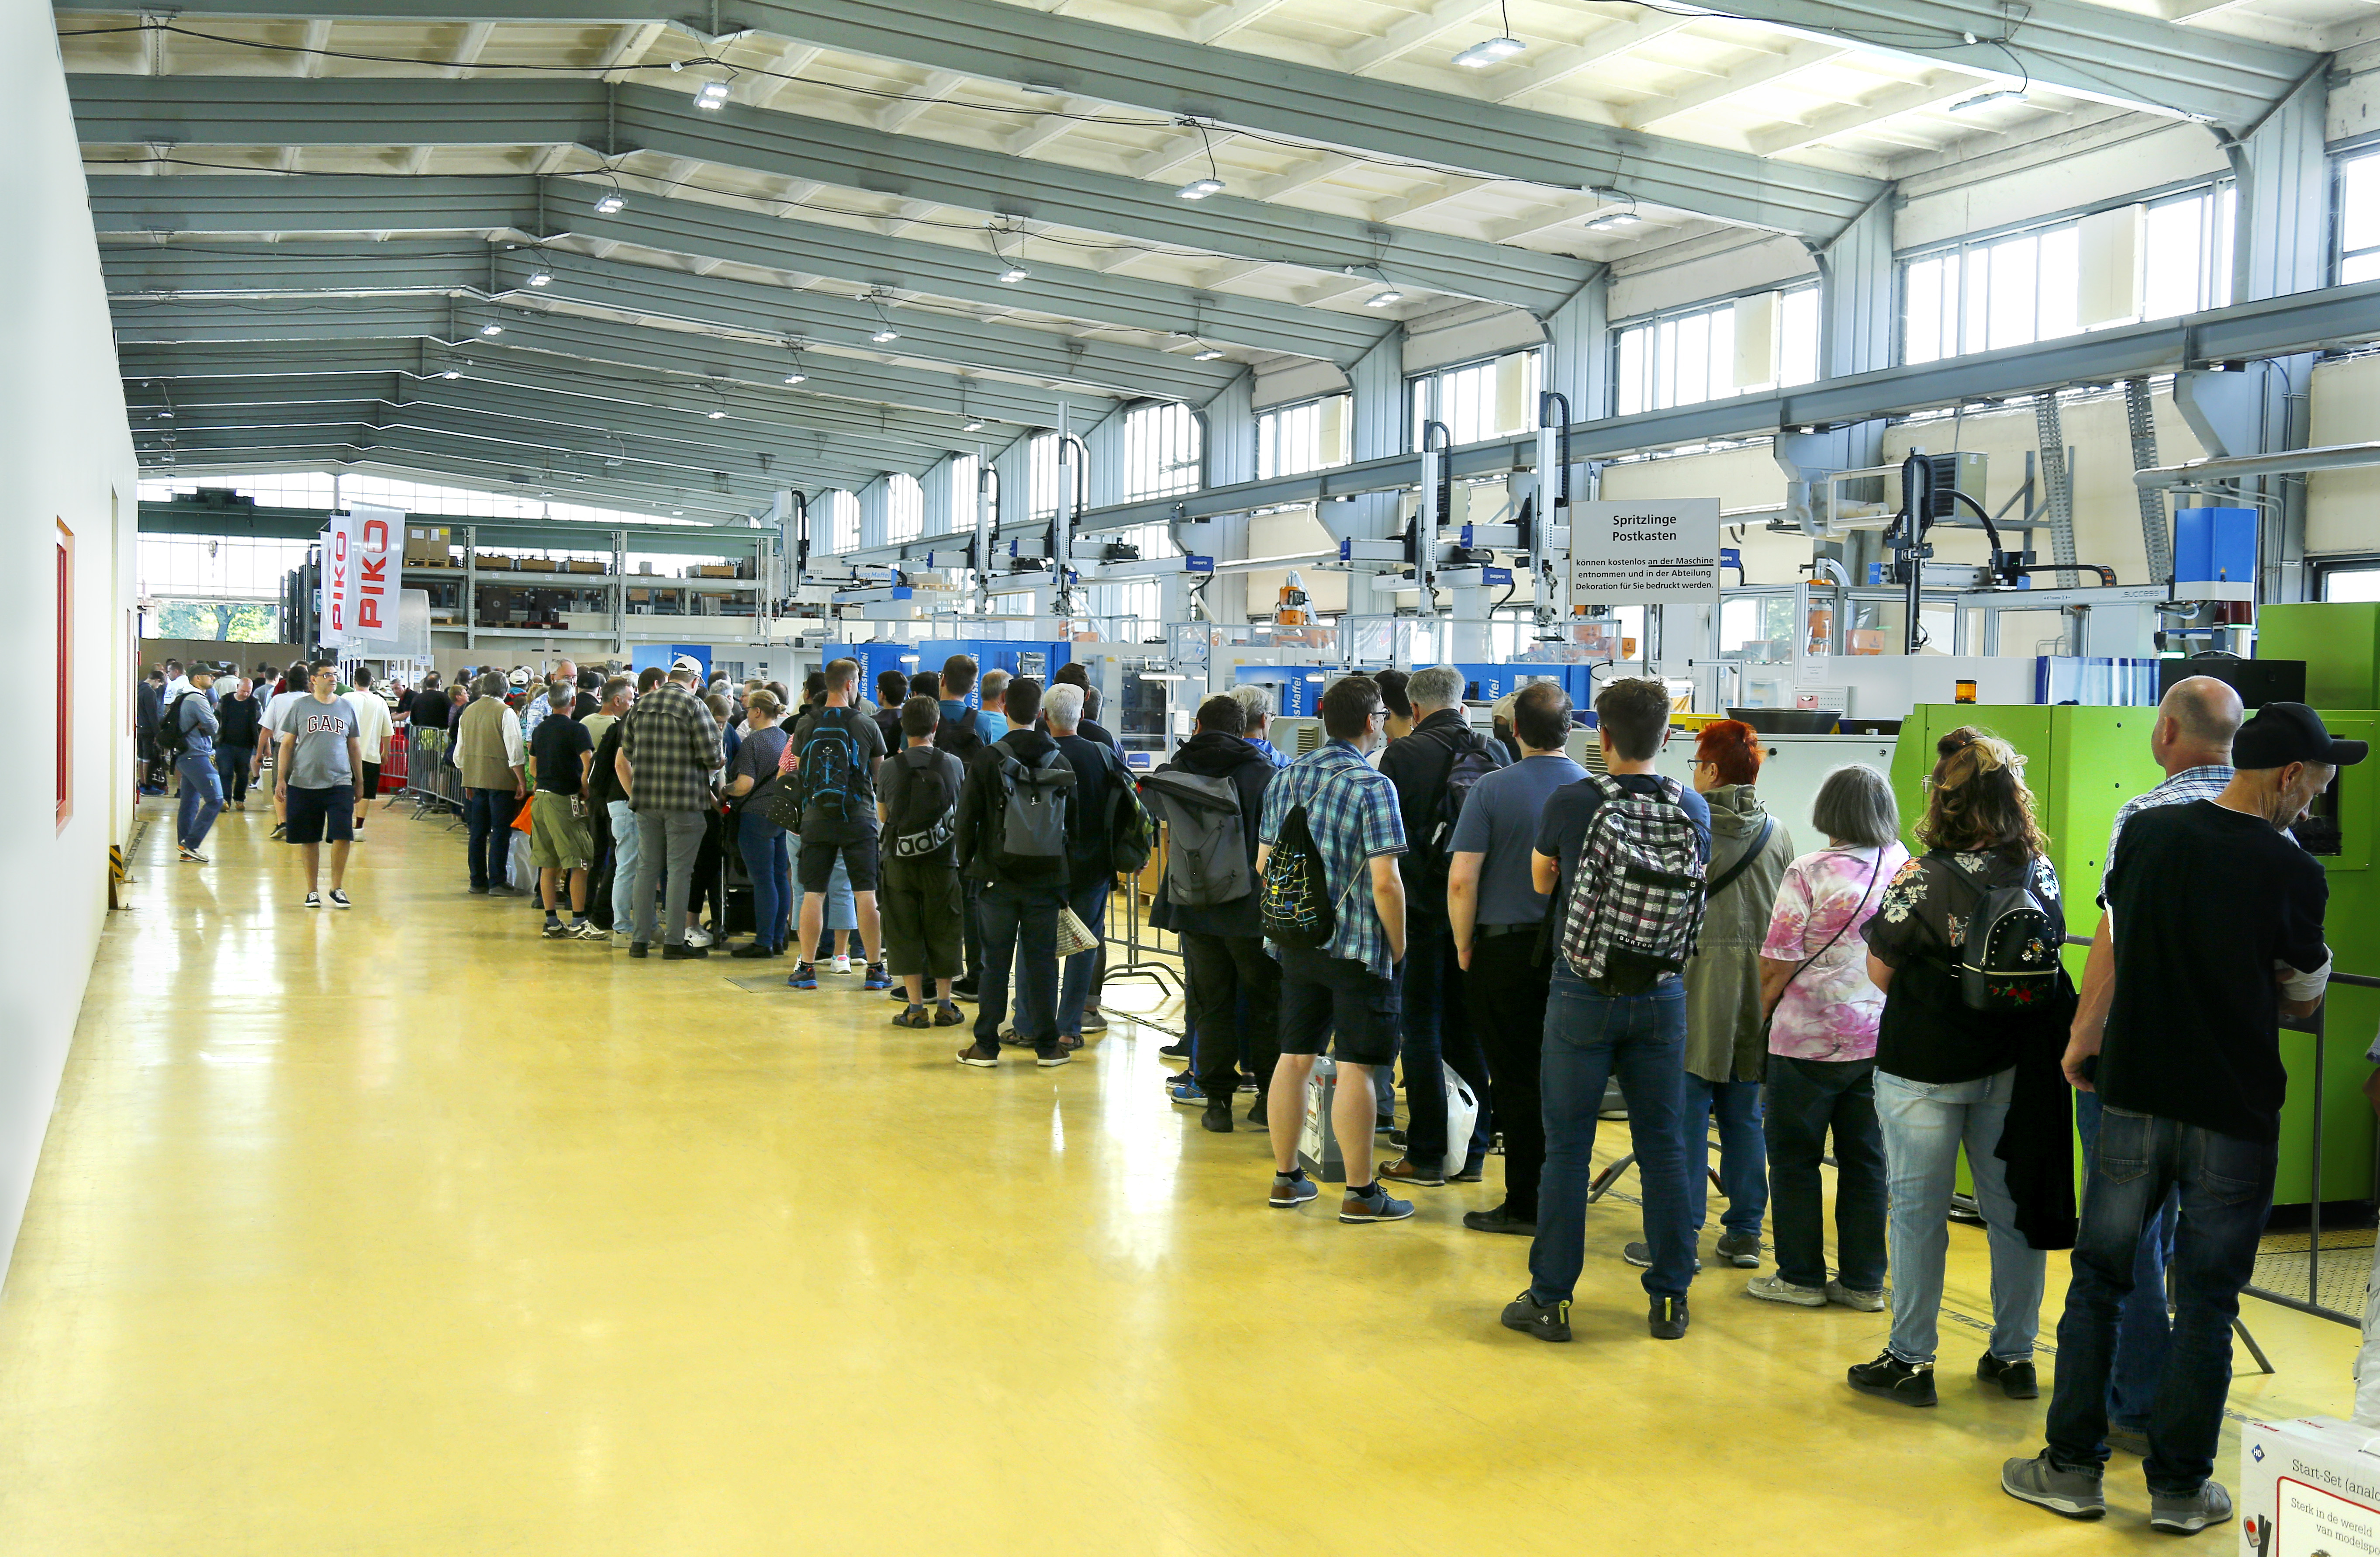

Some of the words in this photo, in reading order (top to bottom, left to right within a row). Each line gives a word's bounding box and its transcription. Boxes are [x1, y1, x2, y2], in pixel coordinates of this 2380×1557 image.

[1613, 514, 1676, 527] Spritzlinge
[1613, 531, 1676, 541] Postkasten
[333, 532, 346, 630] PIKO
[359, 520, 388, 628] PIKO
[1672, 569, 1711, 578] Abteilung
[1489, 678, 1499, 701] ffei
[307, 715, 344, 735] GAP
[1620, 936, 1652, 948] BURTON
[2253, 1423, 2280, 1432] PIKO
[2293, 1459, 2342, 1488] Start-Set
[2291, 1498, 2314, 1515] Sterk
[2316, 1508, 2325, 1519] in
[2327, 1511, 2338, 1524] de
[2341, 1518, 2373, 1538] wereld
[2317, 1524, 2332, 1537] van
